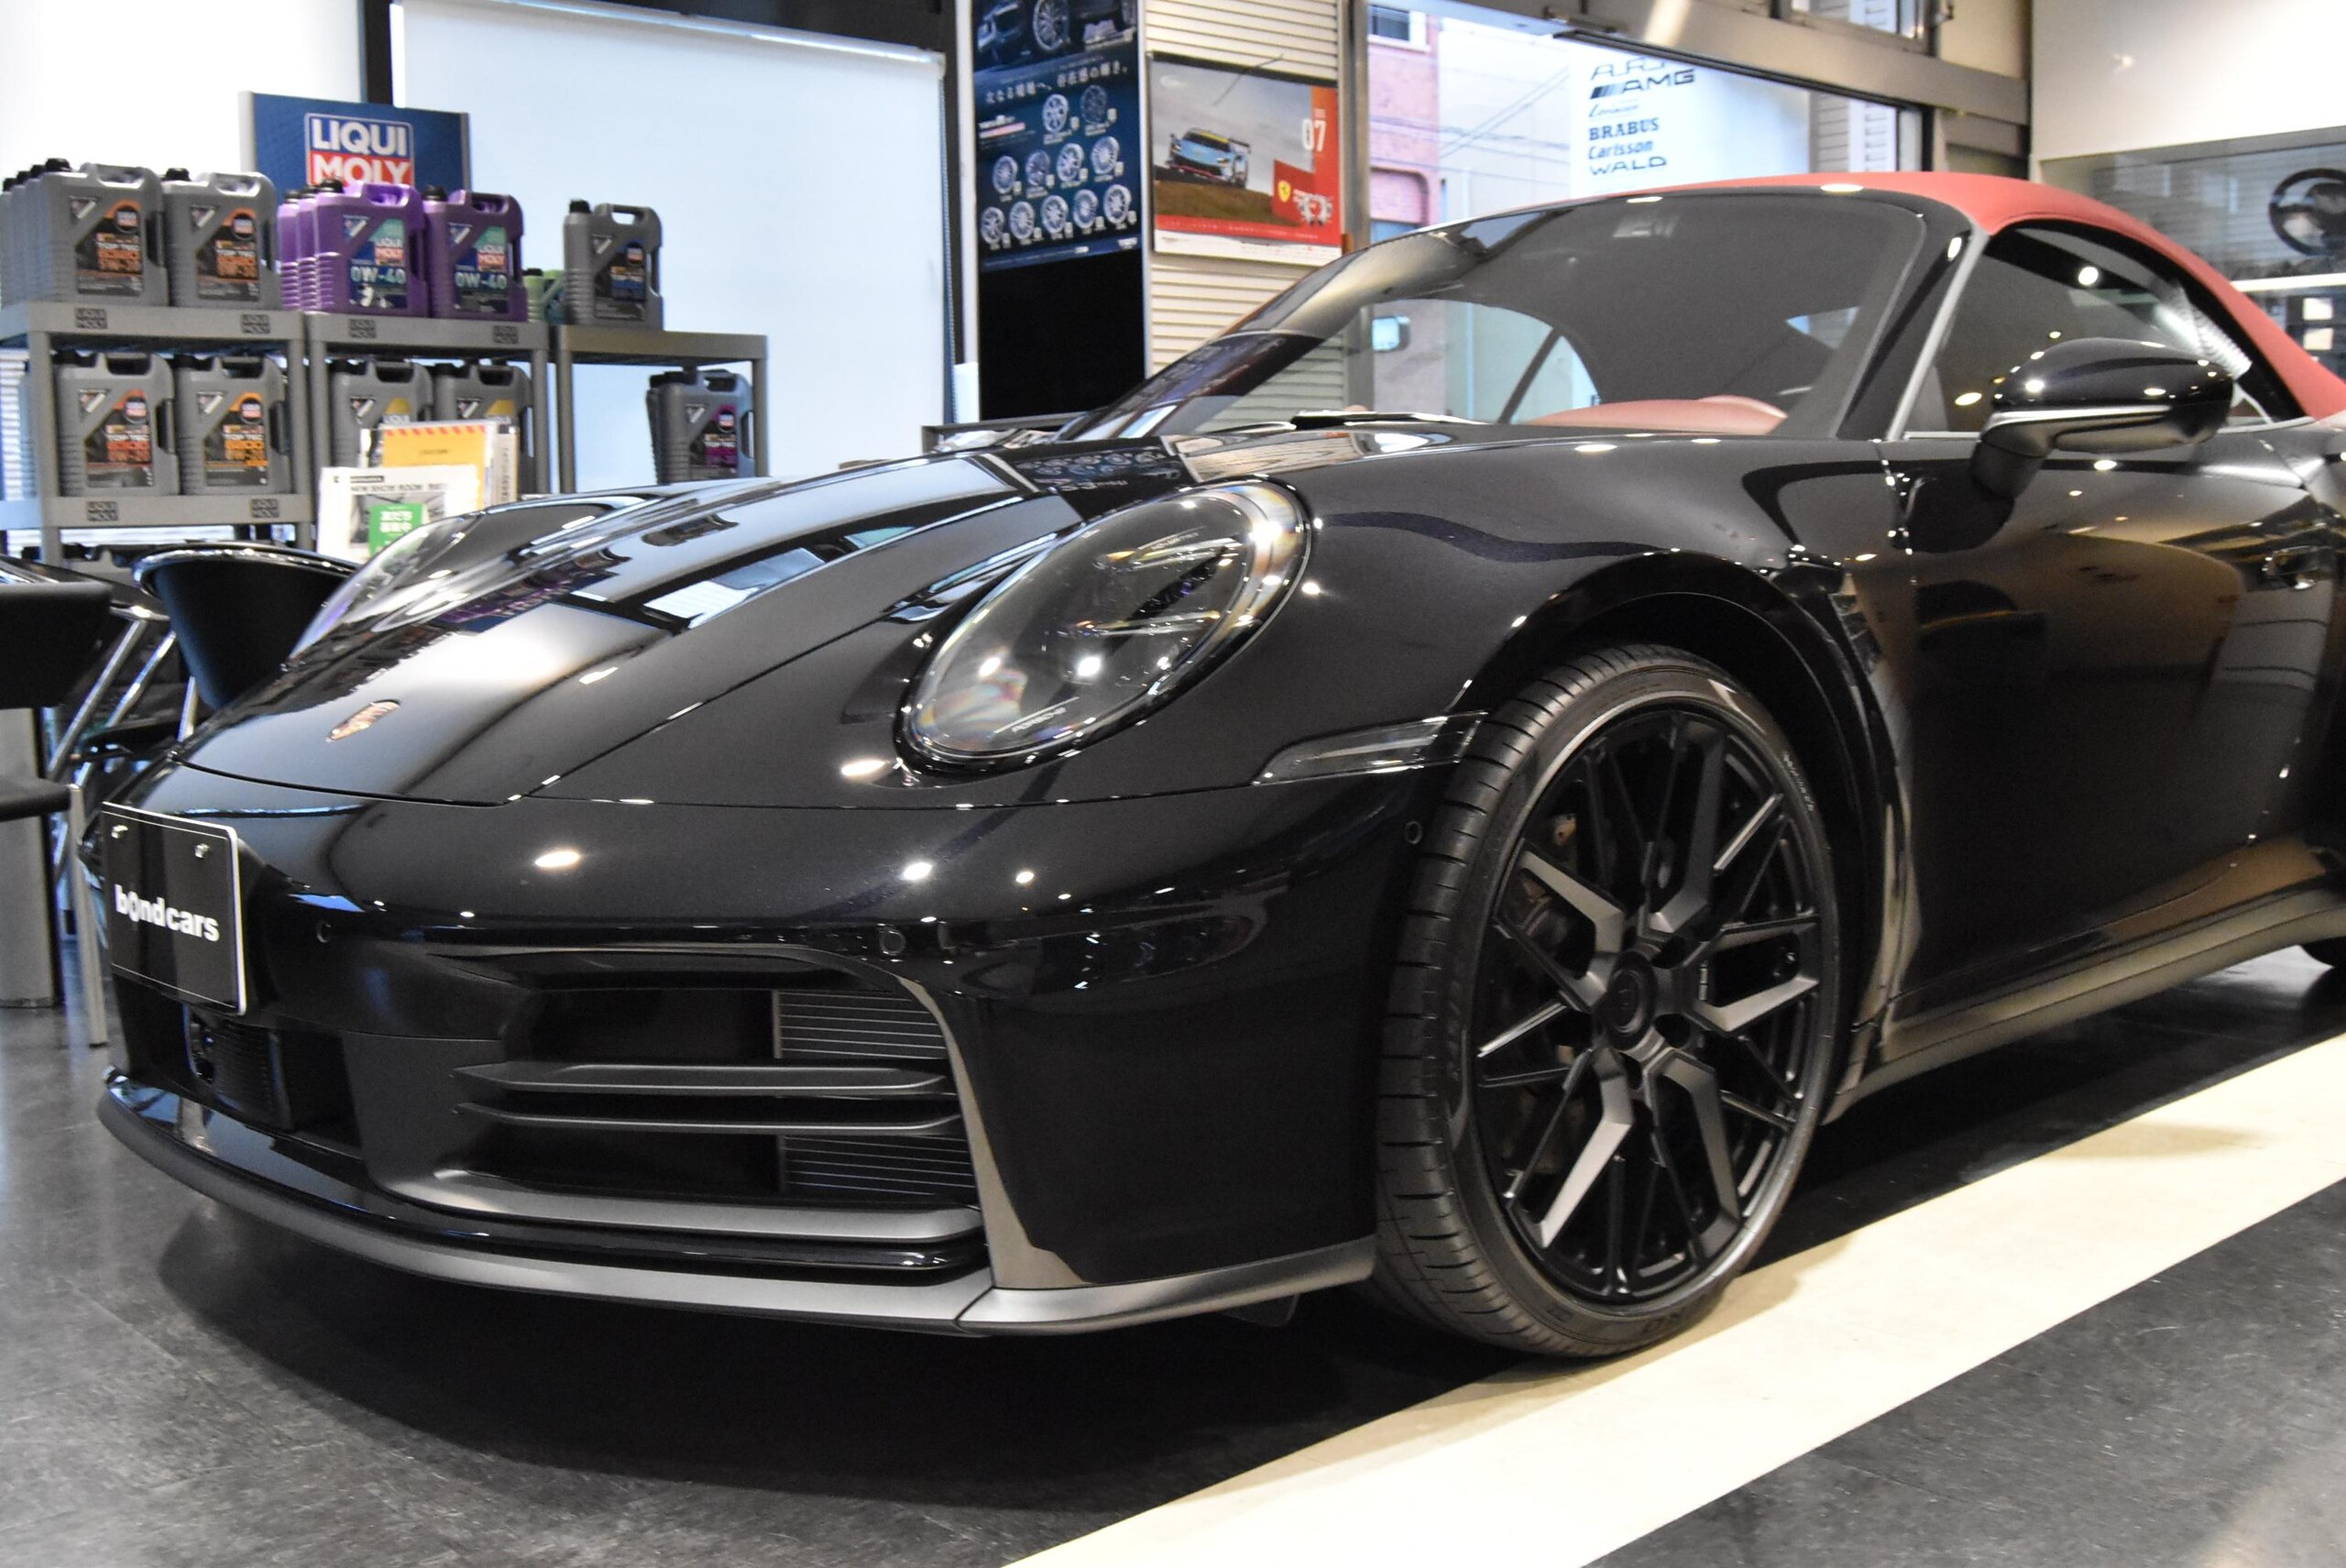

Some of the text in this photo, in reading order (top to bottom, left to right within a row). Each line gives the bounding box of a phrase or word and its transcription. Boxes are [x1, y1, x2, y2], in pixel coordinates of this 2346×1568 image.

[1621, 68, 1695, 93] AMG
[312, 118, 407, 156] LIQUI
[1301, 118, 1326, 152] 07
[1588, 117, 1660, 141] BRABUS
[1588, 140, 1653, 159] Carlsson
[312, 154, 410, 185] MOLY
[1589, 155, 1668, 176] WALD
[350, 266, 407, 285] 0W-40
[455, 271, 508, 290] 0W-40
[115, 883, 221, 942] bondcars
